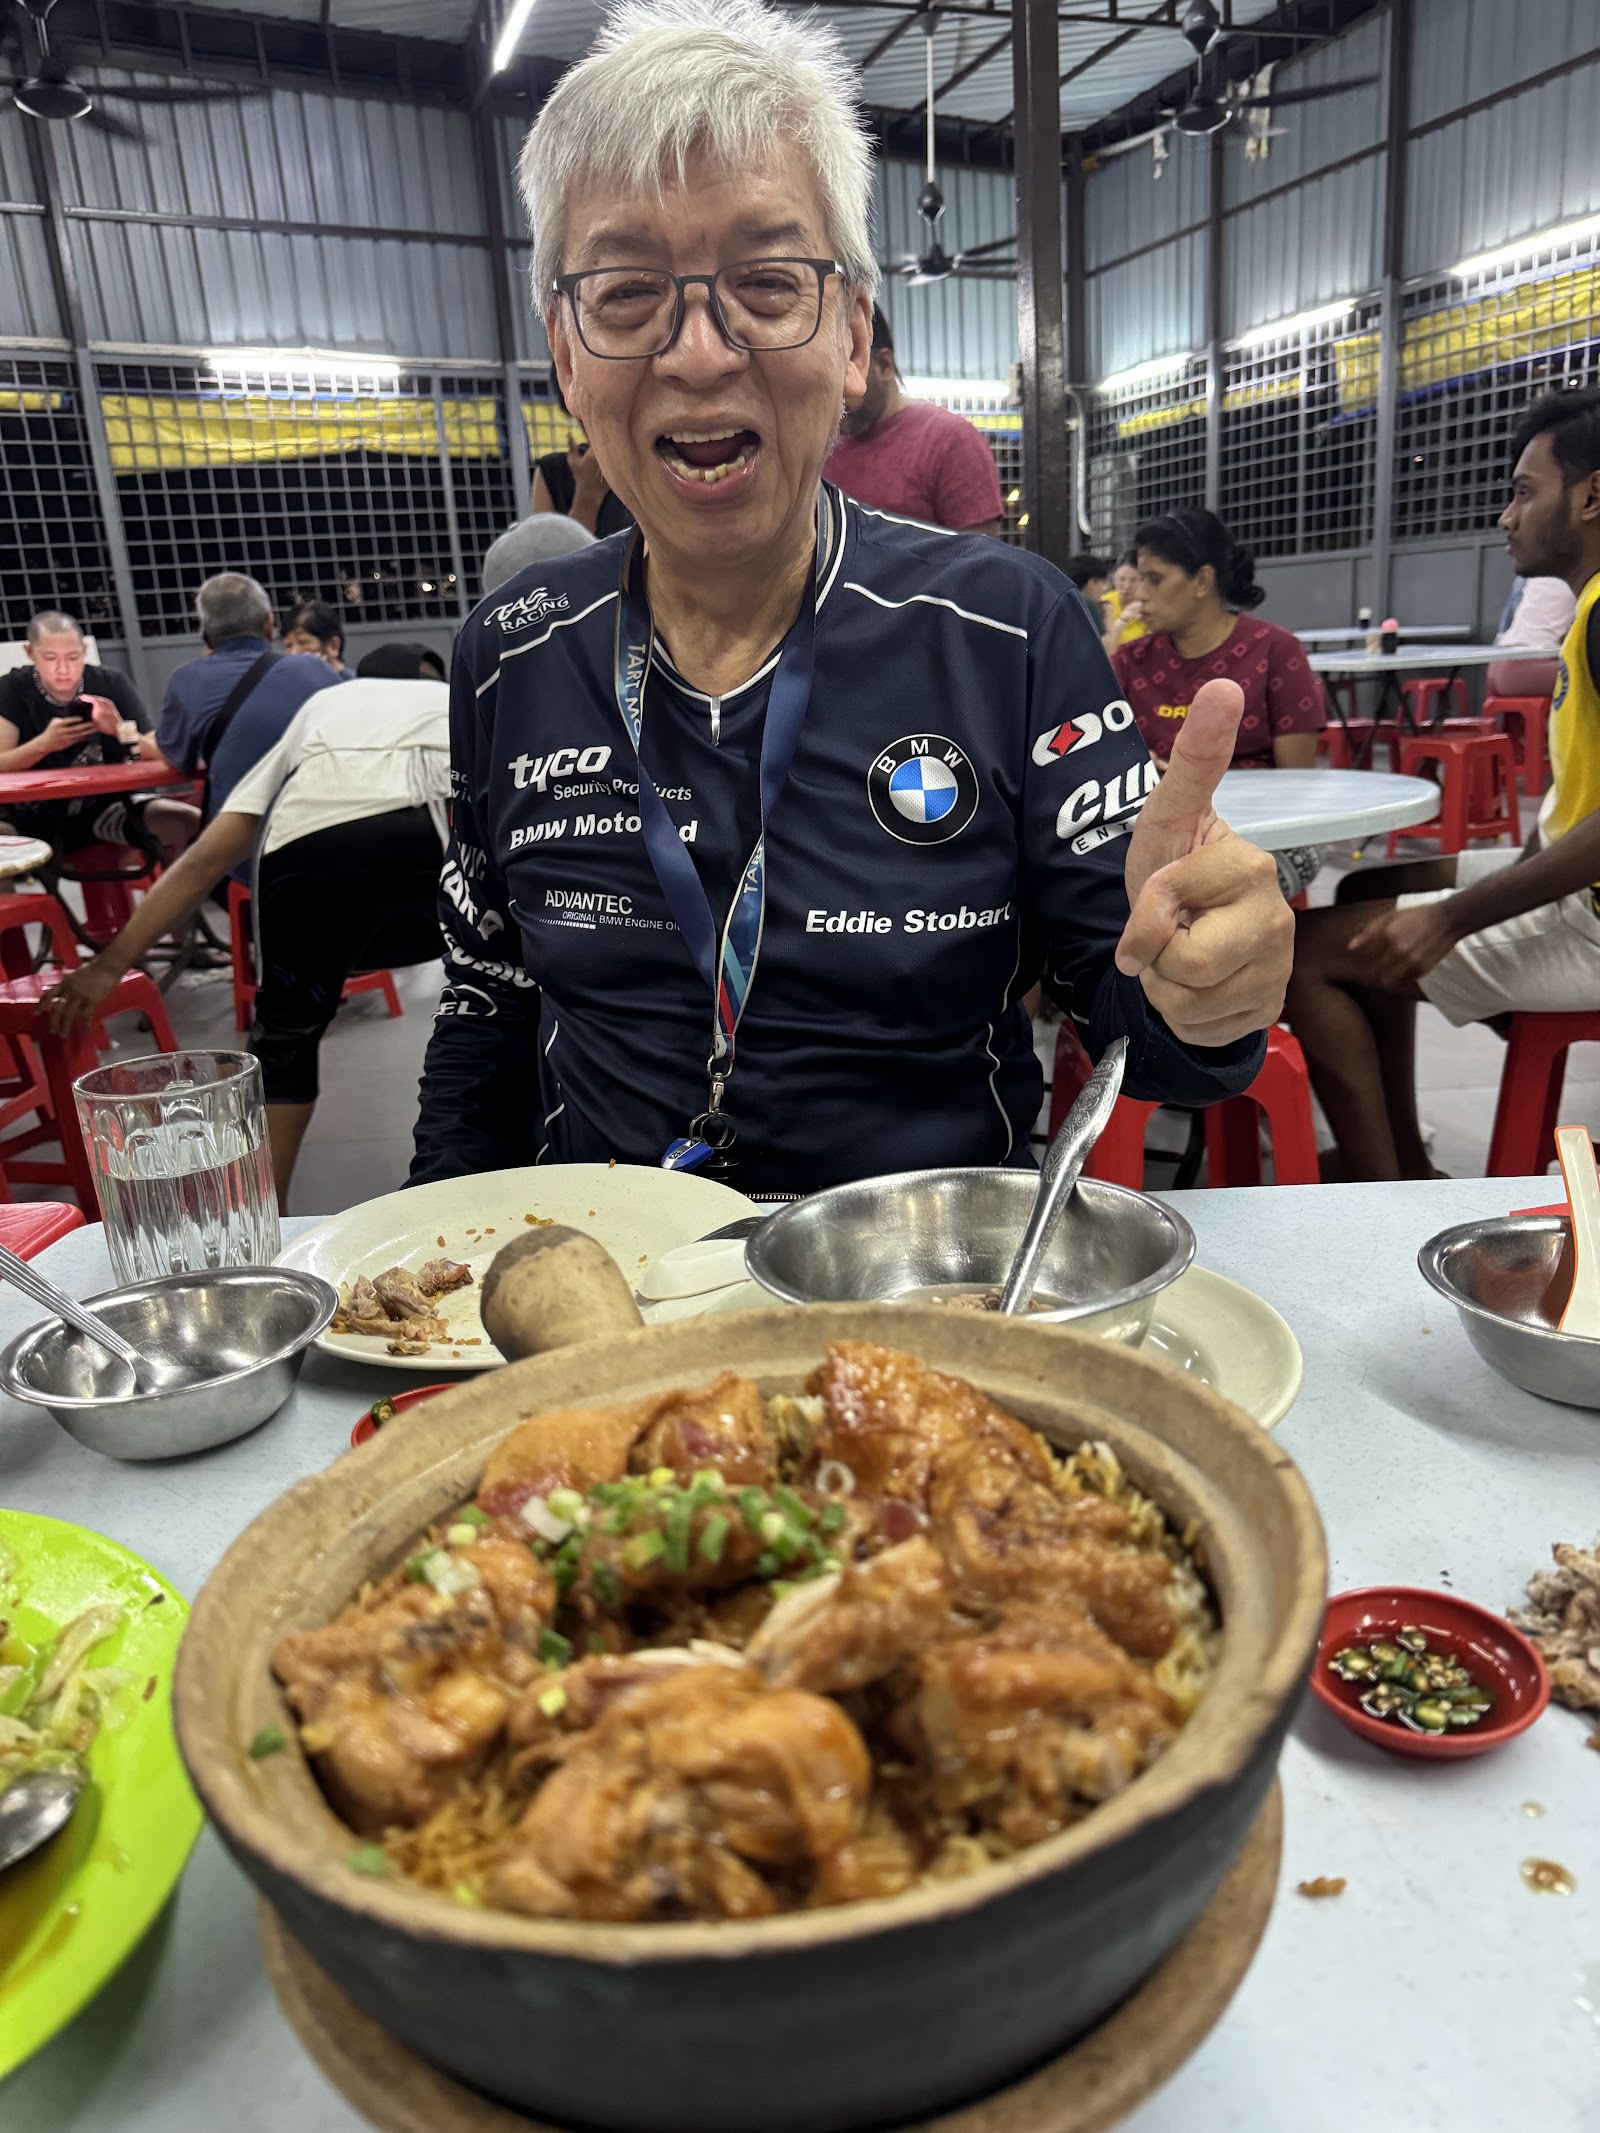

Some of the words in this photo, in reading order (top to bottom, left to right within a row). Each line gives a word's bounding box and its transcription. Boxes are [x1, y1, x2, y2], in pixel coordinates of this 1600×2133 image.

[500, 597, 569, 631] RACING
[508, 745, 612, 793] tyco
[876, 738, 964, 774] BMW
[553, 780, 610, 800] Security
[612, 778, 692, 801] Proucts
[509, 818, 567, 850] BMW
[573, 811, 698, 842] Motod
[544, 889, 633, 914] ADVANTEC
[805, 909, 893, 934] Eddie
[903, 900, 1011, 934] Stobart
[562, 911, 597, 923] ORIGINAL
[599, 915, 623, 926] BMW
[624, 918, 663, 930] ENGINE
